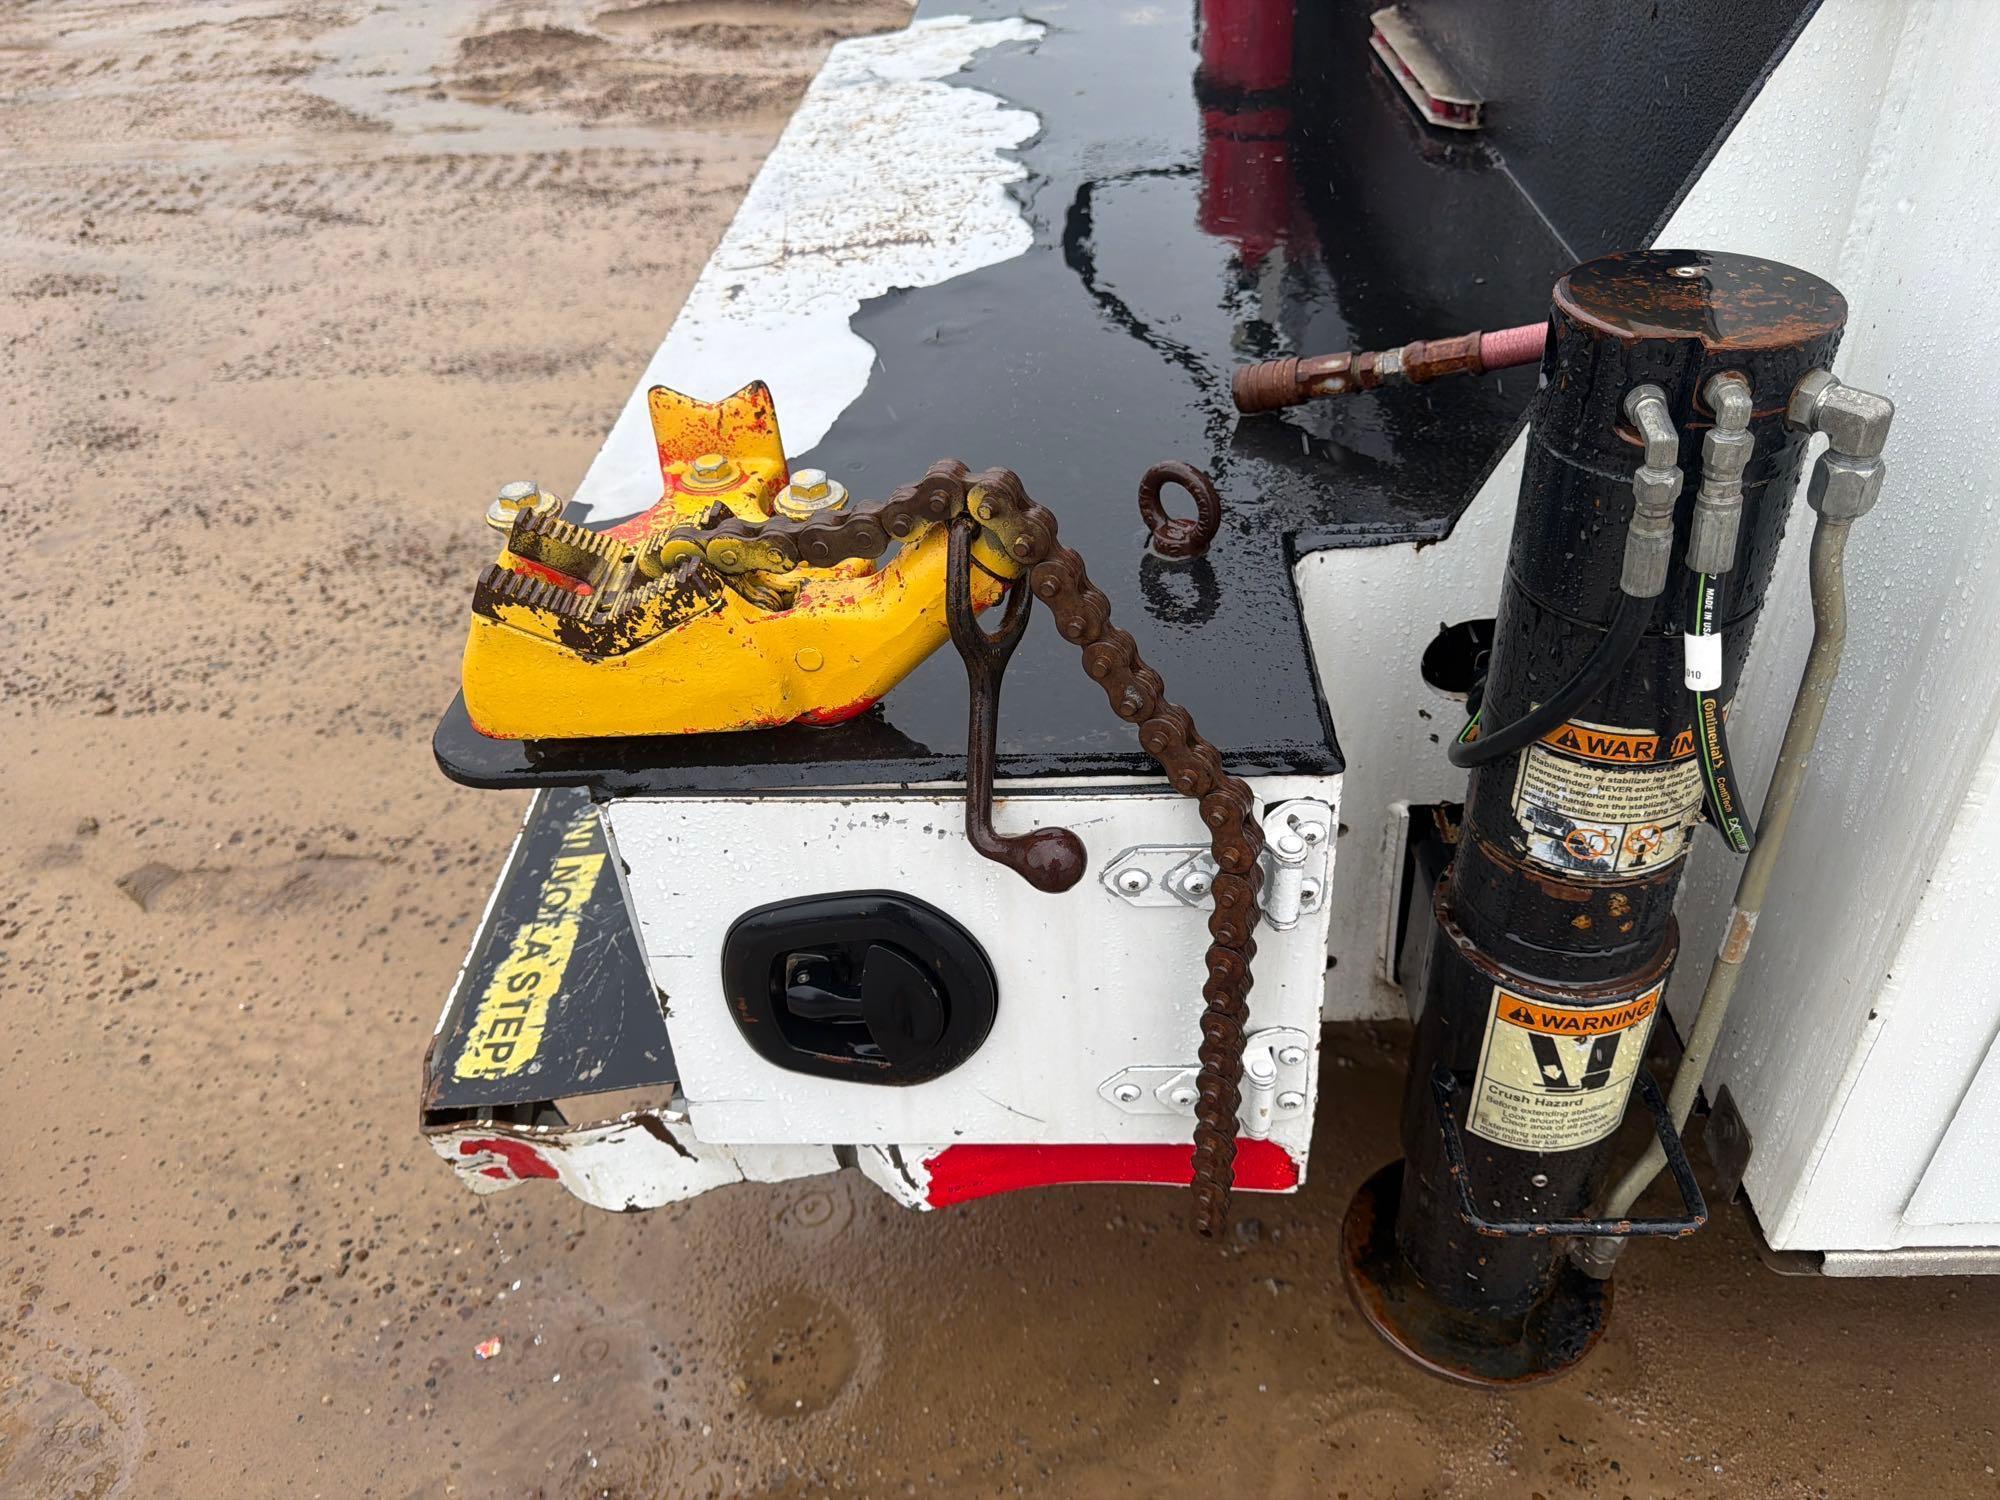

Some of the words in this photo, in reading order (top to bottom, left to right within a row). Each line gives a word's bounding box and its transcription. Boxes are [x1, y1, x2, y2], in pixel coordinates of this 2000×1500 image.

[1704, 588, 1715, 610] MADE
[1703, 612, 1712, 621] IN
[1702, 698, 1723, 761] Continental
[1716, 777, 1733, 813] ContiTech
[1530, 754, 1573, 775] Stabilizer
[1573, 770, 1592, 780] arm
[1607, 777, 1651, 785] stabilizer
[1652, 774, 1666, 783] leg
[1667, 771, 1685, 780] may
[1525, 780, 1544, 794] hold
[1545, 790, 1561, 799] the
[1562, 795, 1595, 808] handle
[1629, 800, 1669, 811] stabilizer
[1527, 772, 1567, 793] sideways
[1569, 788, 1606, 801] beyond
[1644, 793, 1659, 802] pin
[1597, 784, 1633, 793] NEVER
[1634, 784, 1666, 793] extend
[1559, 803, 1601, 818] stabilizer
[1602, 812, 1617, 820] leg
[1619, 812, 1642, 820] from
[1643, 807, 1669, 817] falling
[517, 941, 552, 963] A
[1541, 1000, 1652, 1031] WARNING
[1486, 1094, 1518, 1112] Before
[1520, 1107, 1569, 1118] extending
[1488, 1084, 1531, 1104] Crush
[1535, 1097, 1584, 1108] Hazard
[1481, 1117, 1529, 1138] Extending
[1531, 1131, 1580, 1140] stabilizers
[1501, 1116, 1528, 1128] Clear
[1567, 1122, 1578, 1130] all
[1502, 1110, 1527, 1121] Look
[1529, 1117, 1564, 1125] around
[1480, 1124, 1500, 1138] may
[1502, 1132, 1529, 1144] injure
